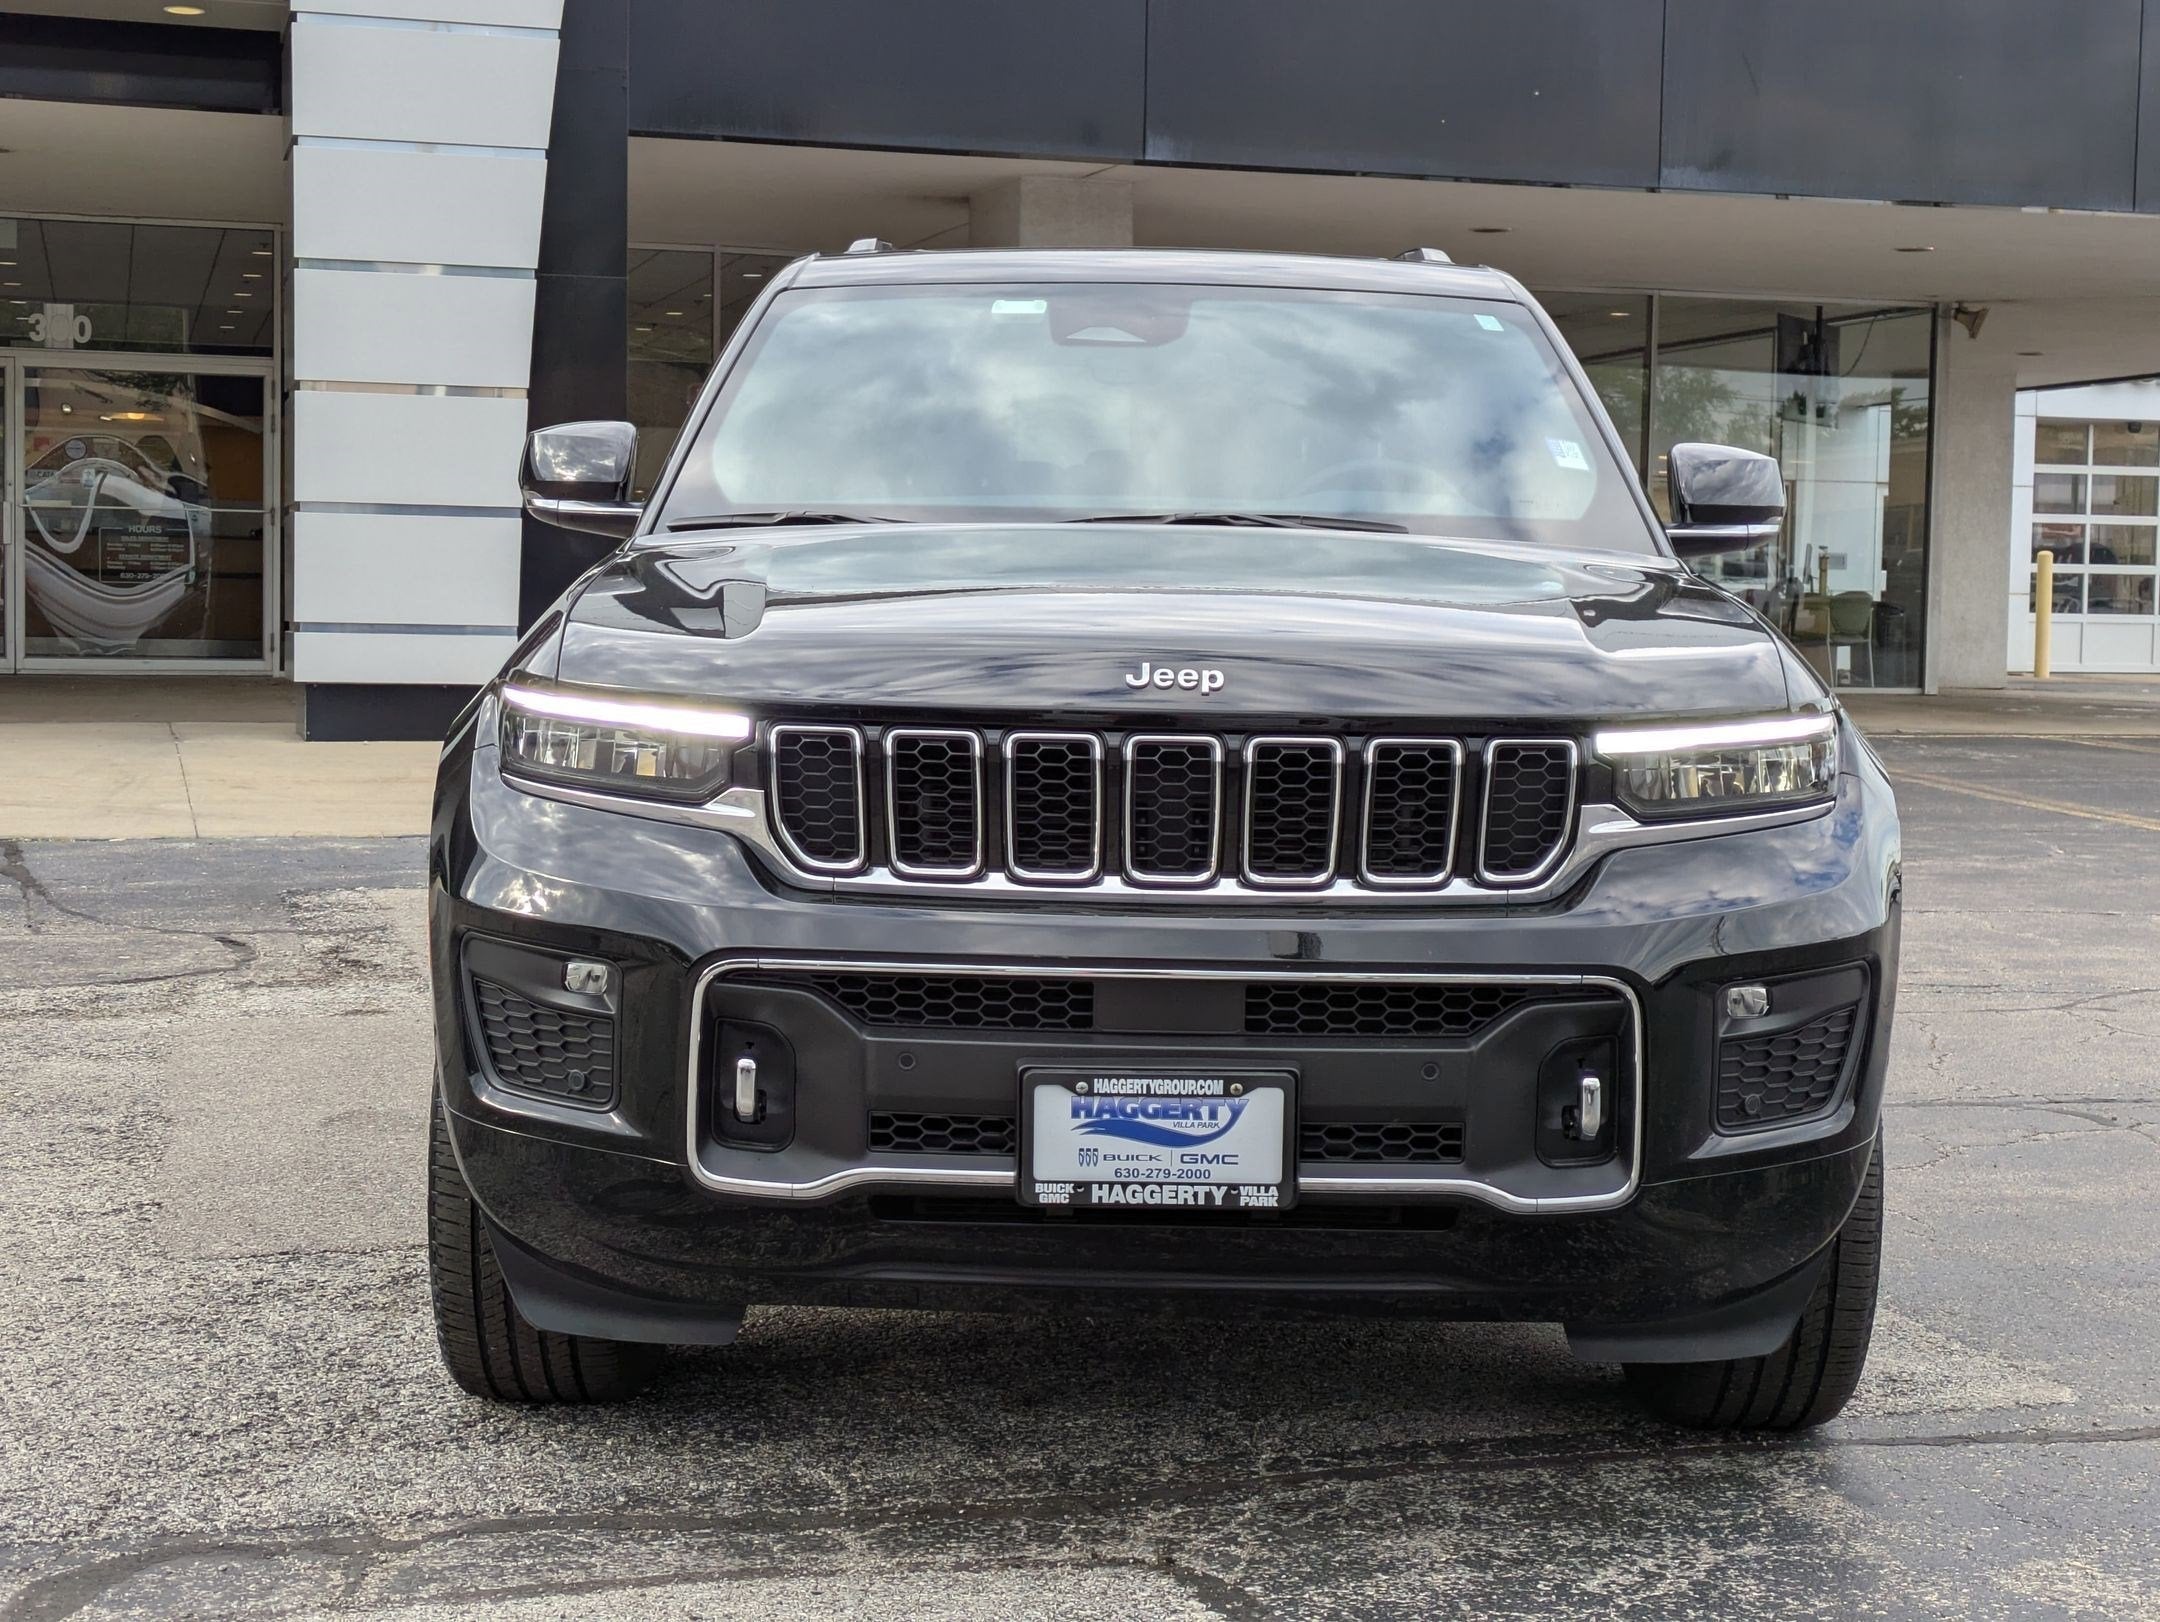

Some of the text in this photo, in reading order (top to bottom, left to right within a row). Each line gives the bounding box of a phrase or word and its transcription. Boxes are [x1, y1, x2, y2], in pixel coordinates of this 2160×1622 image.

[128, 524, 162, 534] HOURS
[1125, 662, 1225, 696] Jeep
[1093, 1078, 1224, 1096] HAGGERTYGROUP.COM
[1070, 1095, 1249, 1121] HAGGERTY
[1172, 1121, 1221, 1129] VILLA PARK
[1103, 1153, 1239, 1165] BUICK GMC
[1114, 1167, 1211, 1180] 630-279-2000
[1034, 1183, 1075, 1194] BUICK
[1091, 1183, 1229, 1206] HAGGERTY
[1239, 1185, 1279, 1197] VILLA
[1039, 1193, 1070, 1204] GMC
[1239, 1196, 1279, 1207] PARK
